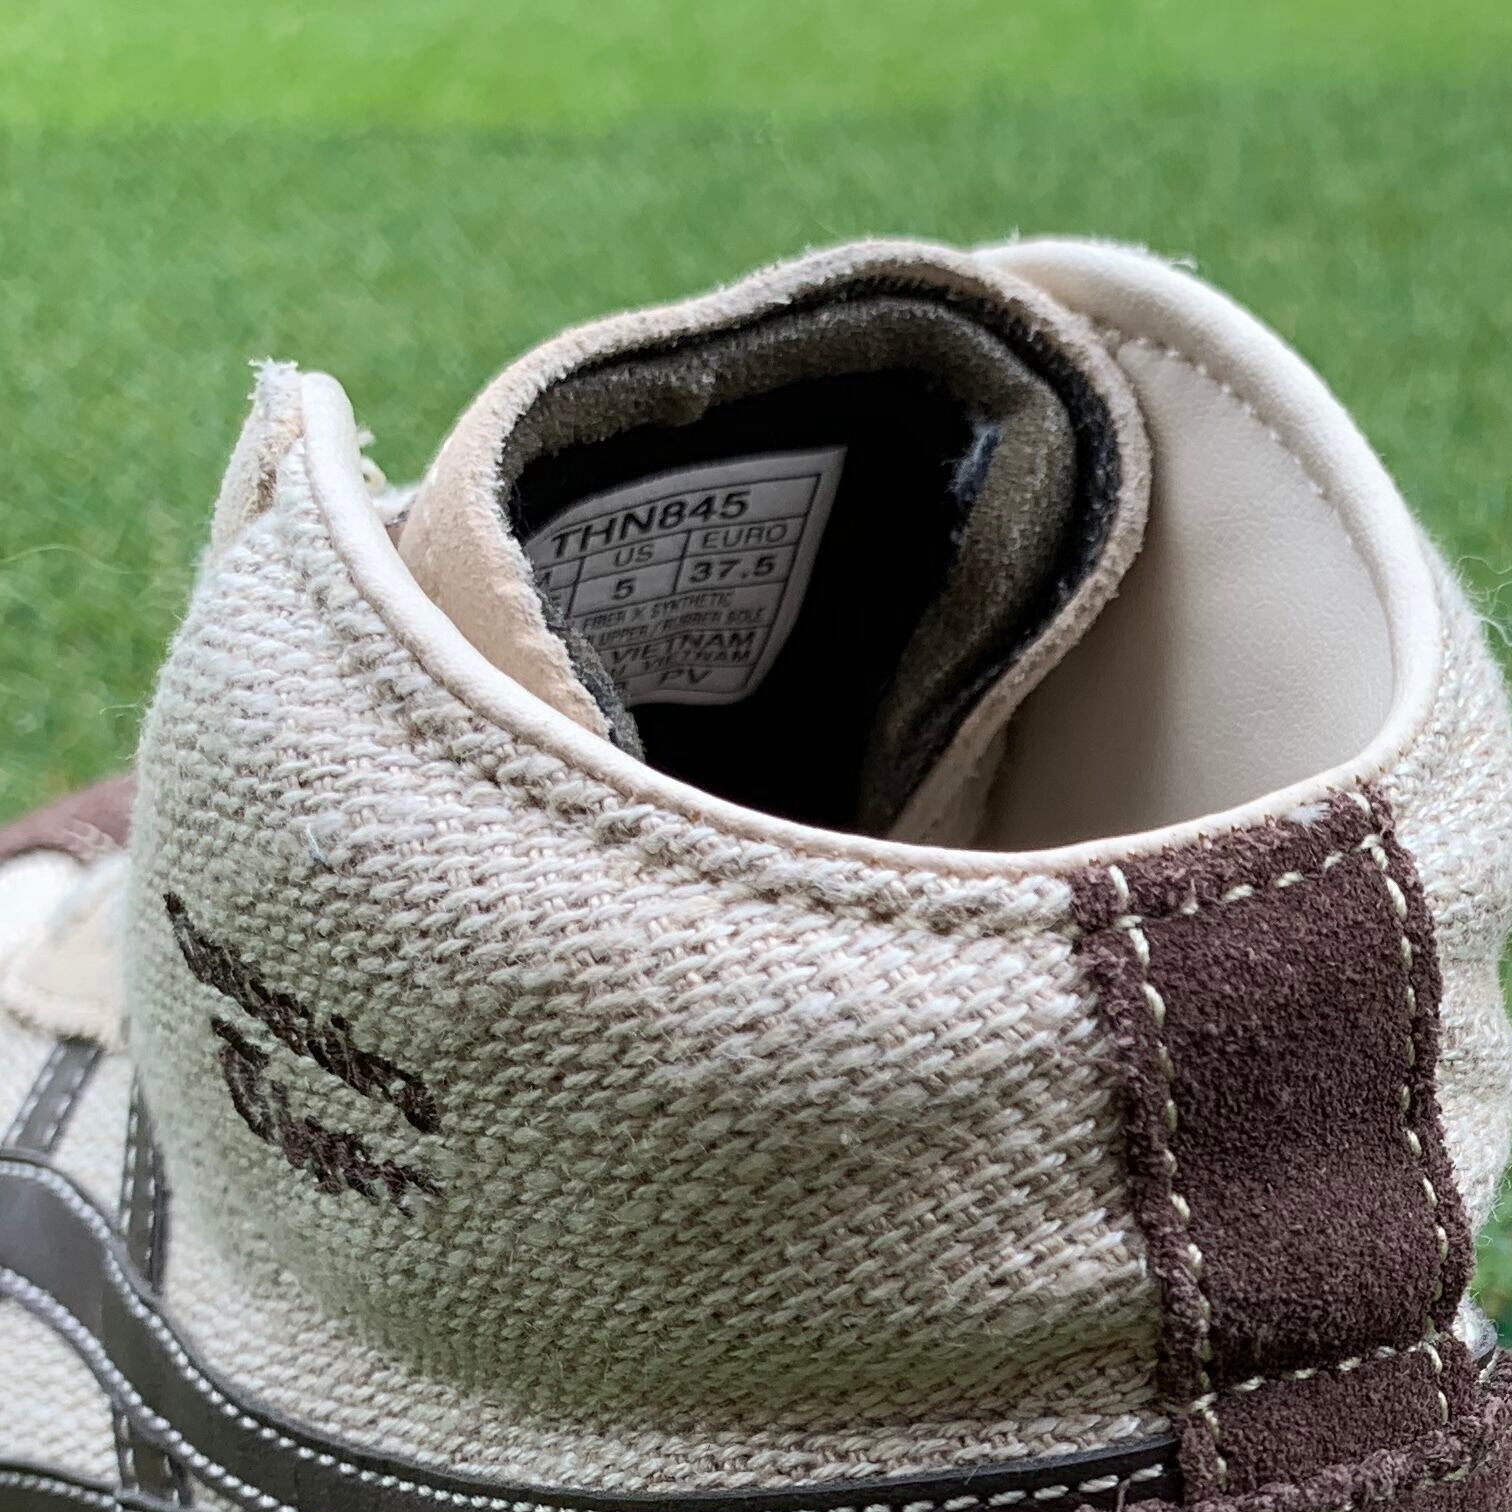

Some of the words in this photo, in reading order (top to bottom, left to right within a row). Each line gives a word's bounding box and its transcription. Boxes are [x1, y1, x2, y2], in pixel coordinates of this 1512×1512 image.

[551, 490, 751, 559] THN845
[614, 543, 655, 567] US
[703, 523, 789, 549] EURO
[613, 577, 637, 601] 5
[690, 555, 777, 584] 37.5
[657, 668, 712, 687] PV
